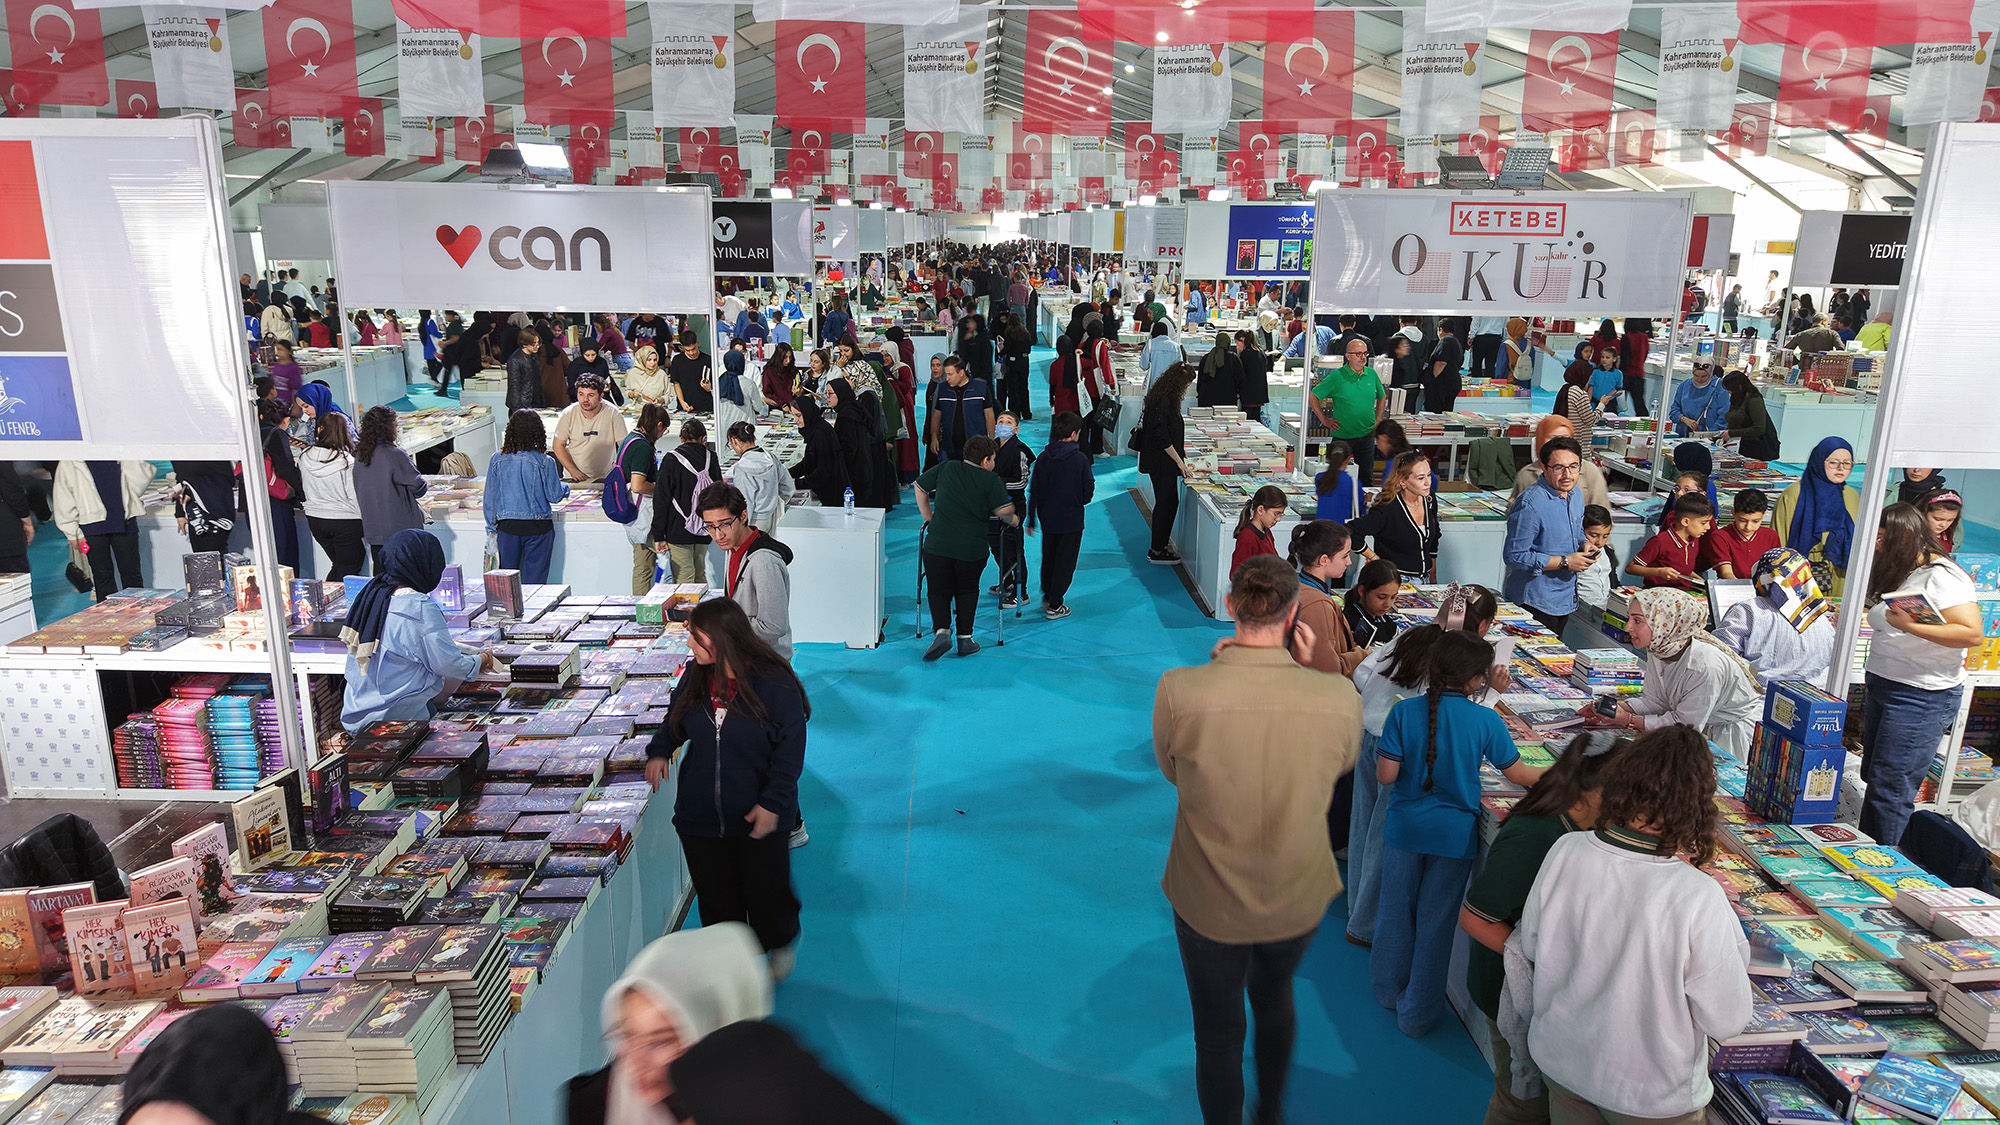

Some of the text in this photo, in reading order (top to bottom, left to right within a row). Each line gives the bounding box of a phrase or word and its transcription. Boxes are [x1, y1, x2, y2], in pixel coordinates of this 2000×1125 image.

[151, 30, 209, 39] Kahramanmaraş
[153, 38, 209, 50] Büyükşehir Belediyesi
[401, 38, 459, 48] Kahramanmaraş
[1917, 44, 1976, 54] Kahramanmaraş
[402, 48, 459, 58] Büyükşehir Belediyesi
[655, 47, 714, 56] Kahramanmaraş
[1664, 51, 1721, 61] Kahramanmaraş
[655, 57, 714, 67] Büyükşehir Belediyesi
[908, 54, 965, 62] Kahramanmaraş
[1406, 56, 1464, 65] Kahramanmaraş
[1915, 53, 1975, 65] Büyükşehir Belediyesi
[908, 63, 965, 73] Büyükşehir Belediyesi
[1157, 66, 1187, 76] Büyükşehir
[1405, 64, 1463, 76] Büyükşehir Belediyesi
[1663, 60, 1719, 72] Büyükşehir Belediyesi
[1459, 210, 1557, 228] KETEBE
[717, 223, 731, 235] Y
[488, 225, 611, 271] can
[7, 421, 41, 436] FENER
[1811, 715, 1841, 732] TUHAF
[329, 767, 342, 781] ALTI
[85, 918, 102, 929] HER
[148, 916, 168, 929] HER
[76, 926, 114, 940] KİMSEN
[140, 924, 180, 941] KİMSEN
